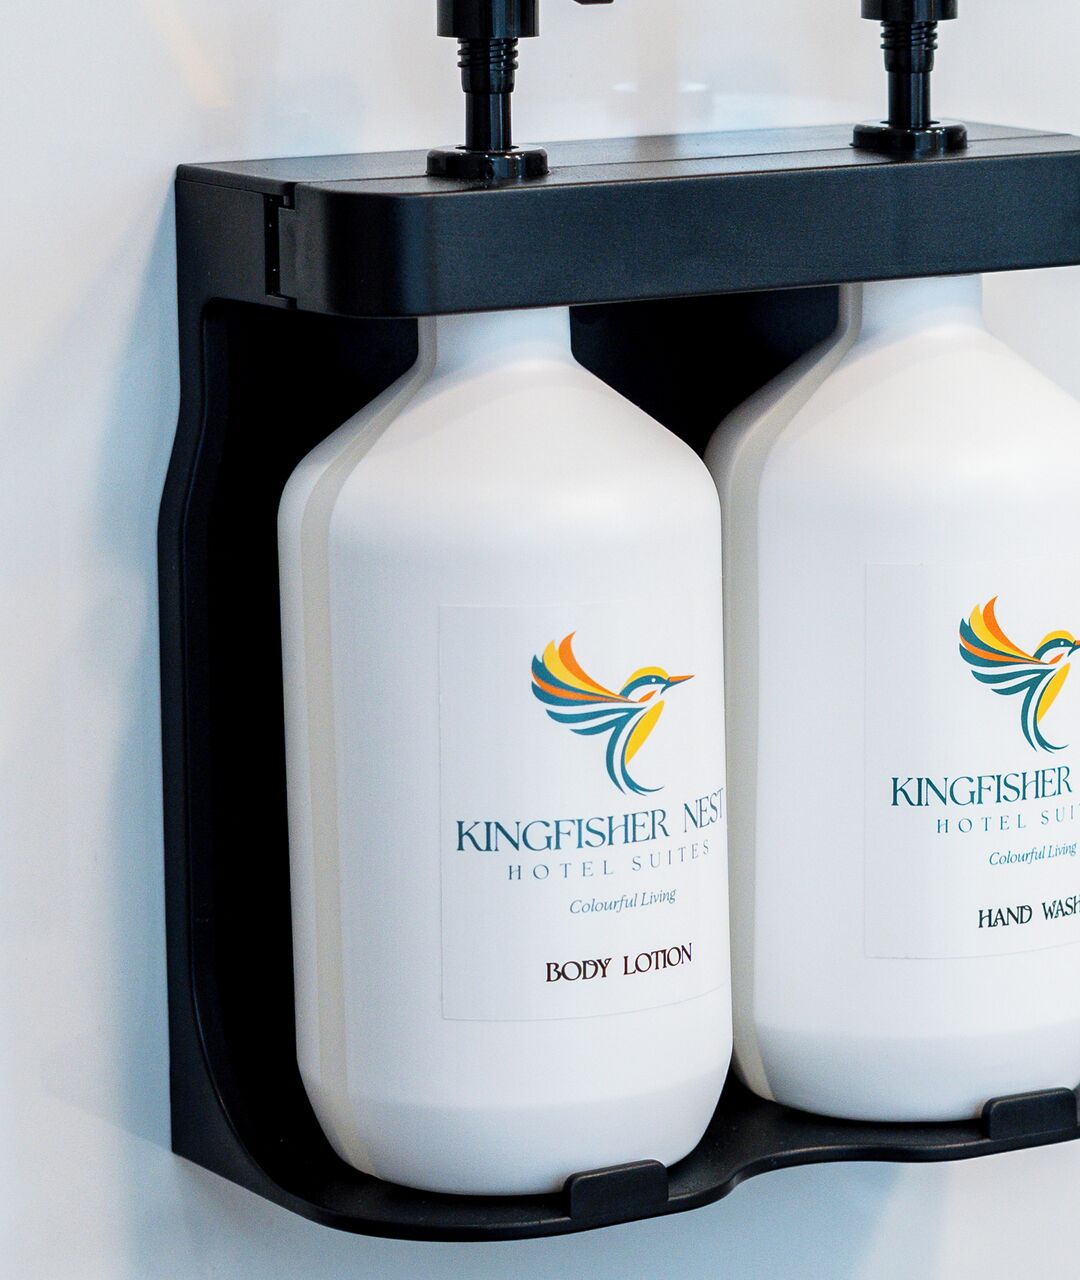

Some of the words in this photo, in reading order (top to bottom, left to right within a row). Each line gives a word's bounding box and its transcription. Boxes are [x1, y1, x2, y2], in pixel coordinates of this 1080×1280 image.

[891, 765, 1073, 807] KINGFISHER
[456, 808, 671, 853] KINGFISHER
[683, 787, 725, 833] NEST
[936, 814, 1027, 834] HOTEL
[508, 858, 614, 881] HOTEL
[631, 839, 711, 872] SUITES
[989, 844, 1046, 866] Colourful
[1048, 841, 1078, 858] Living
[569, 892, 638, 915] Colourful
[640, 887, 677, 907] Living
[977, 904, 1033, 929] HAND
[545, 957, 612, 983] BODY
[623, 942, 693, 978] LOTION
